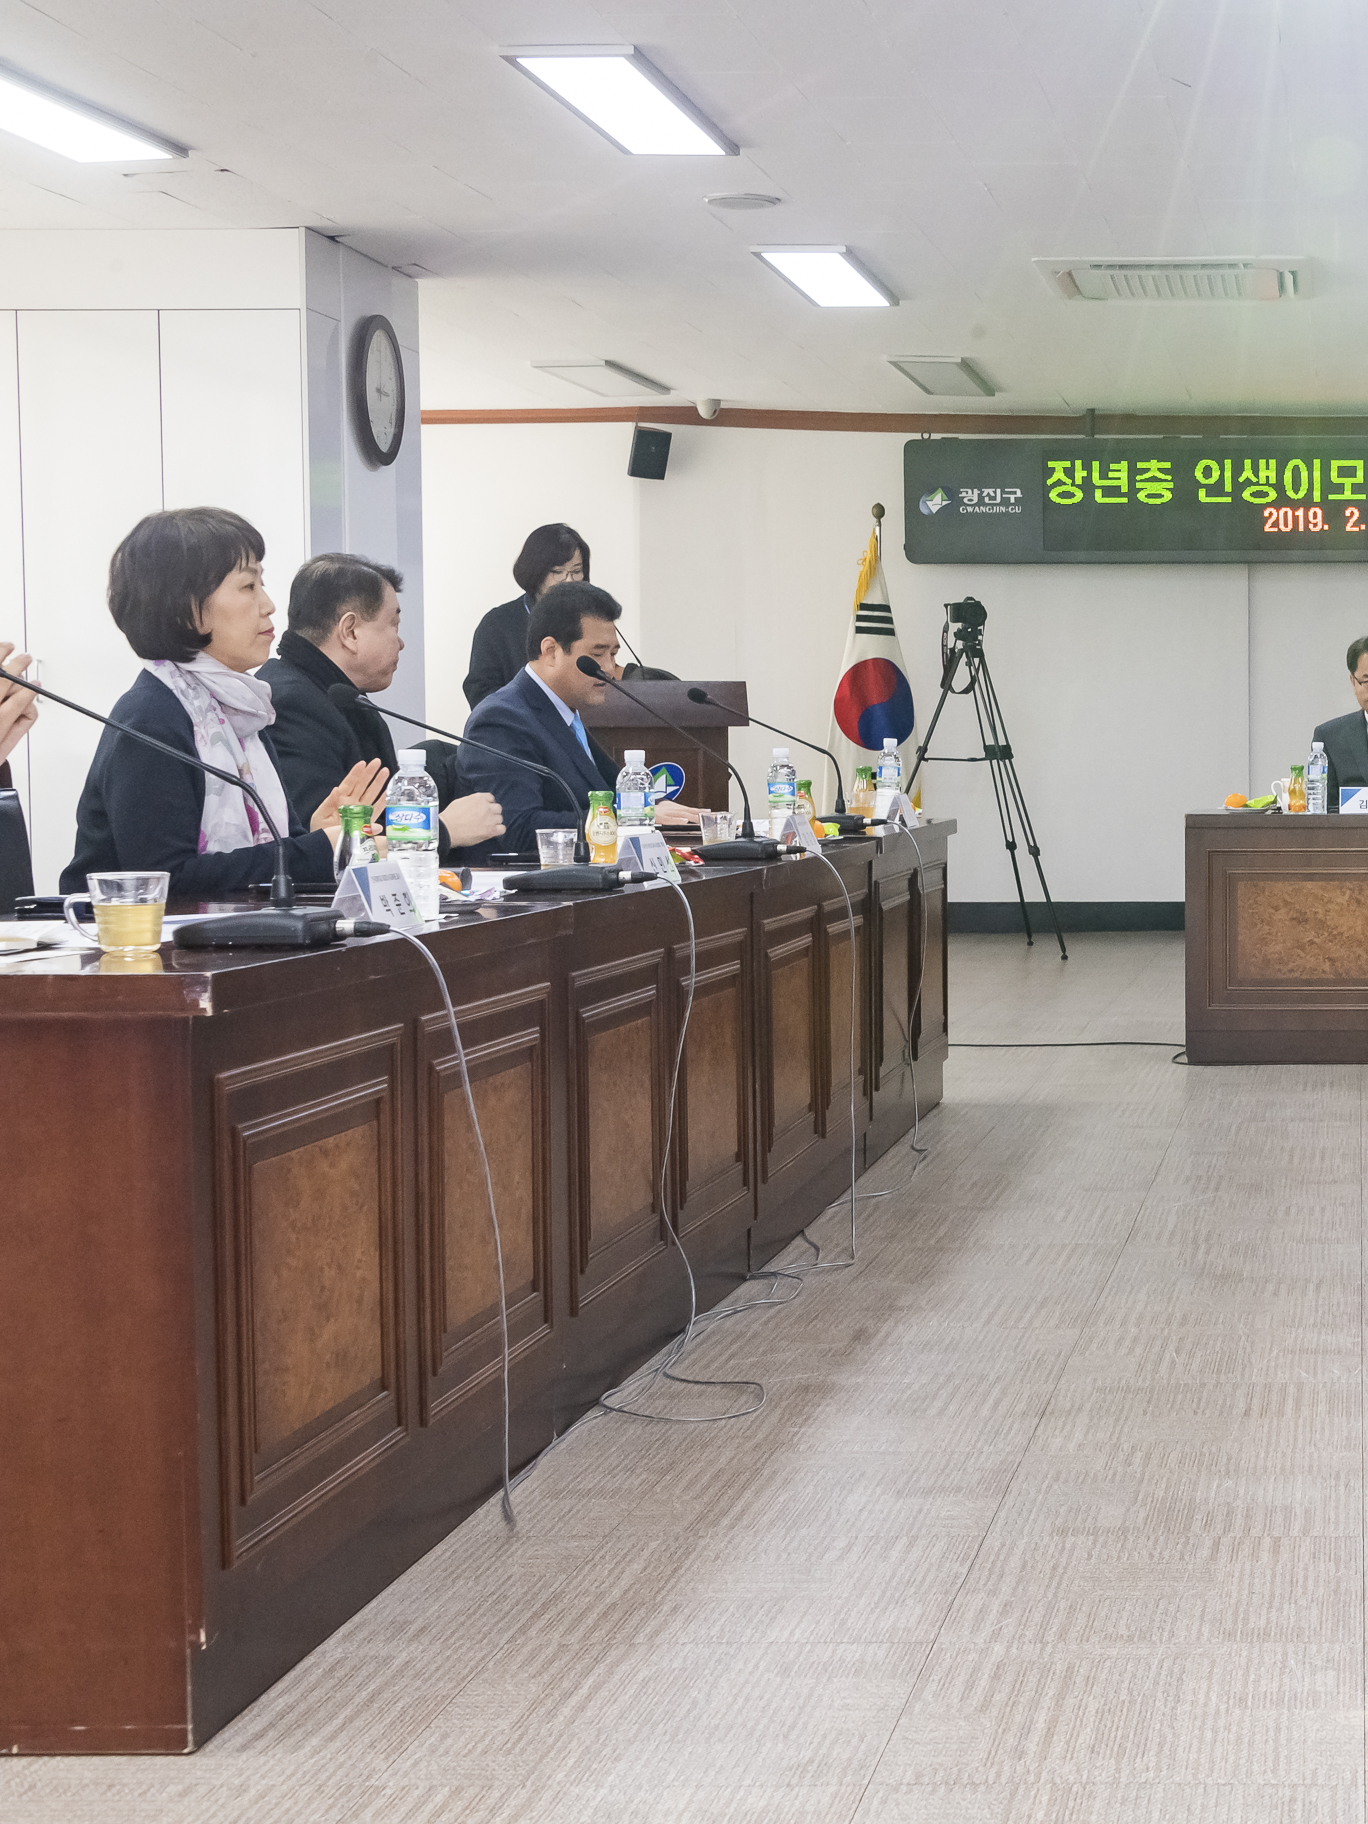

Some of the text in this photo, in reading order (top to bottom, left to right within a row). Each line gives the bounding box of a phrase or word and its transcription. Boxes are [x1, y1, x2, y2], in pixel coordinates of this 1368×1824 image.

[1047, 459, 1174, 505] 장년층
[958, 488, 1023, 505] 광진구
[959, 505, 1022, 514] GWANGJIN-GU
[1263, 507, 1330, 532] 2019.
[1344, 507, 1366, 532] 2.
